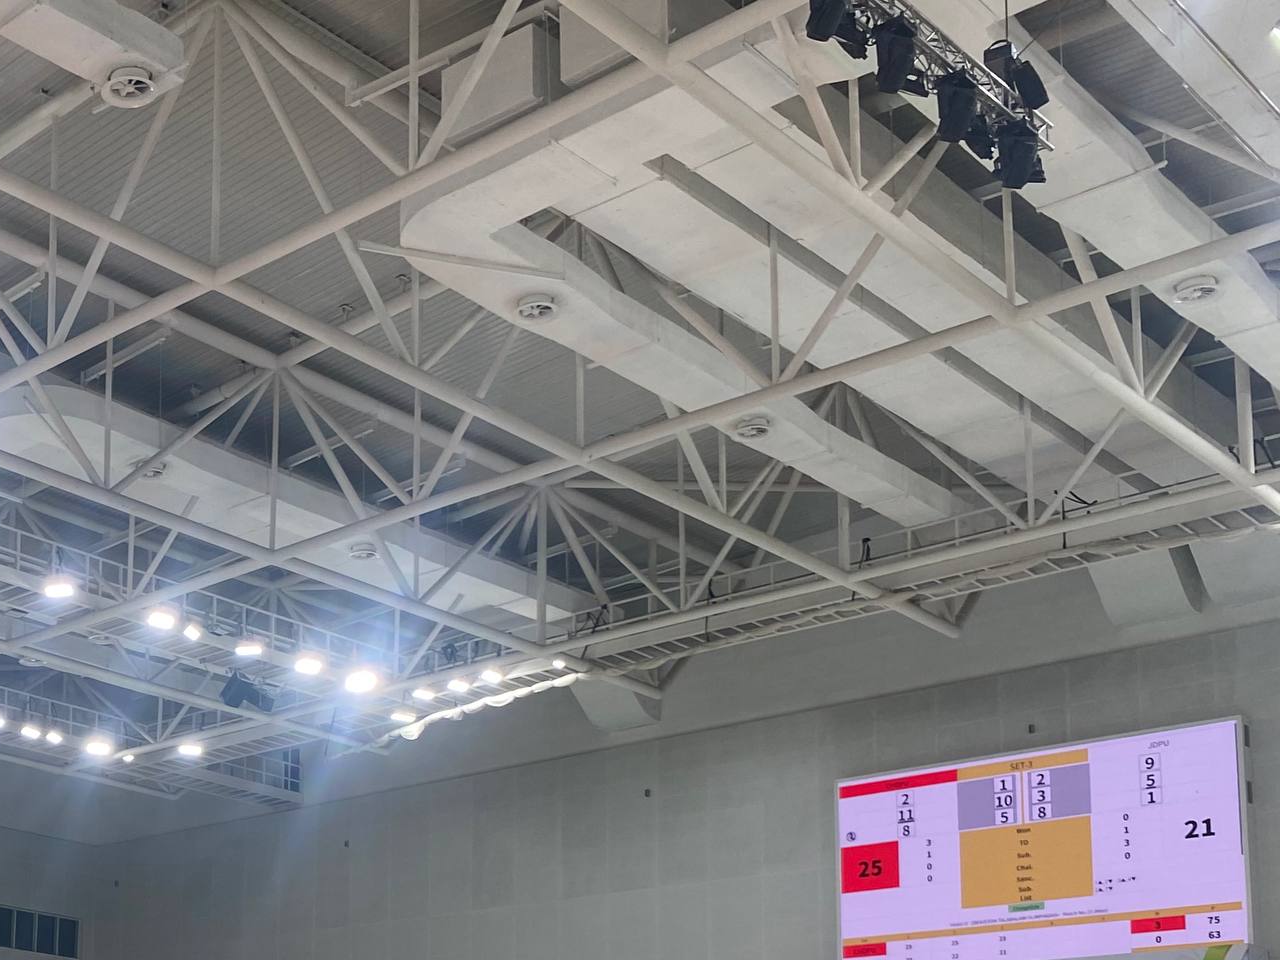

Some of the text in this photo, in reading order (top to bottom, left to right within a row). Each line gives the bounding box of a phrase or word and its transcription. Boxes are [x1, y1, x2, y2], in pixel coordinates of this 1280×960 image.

[1145, 757, 1155, 770] 9
[999, 779, 1008, 791] 1
[1037, 774, 1046, 786] 2
[1146, 774, 1156, 787] 5
[901, 793, 910, 805] 2
[995, 795, 1013, 807] 10
[1037, 791, 1046, 802] 3
[1147, 792, 1156, 804] 1
[898, 809, 915, 822] 11
[1000, 811, 1009, 823] 5
[1037, 807, 1047, 819] 8
[1123, 813, 1129, 821] 0
[902, 825, 910, 836] 8
[1184, 818, 1216, 839] 21
[858, 860, 882, 877] 25
[1207, 916, 1221, 925] 75
[1208, 931, 1221, 939] 63
